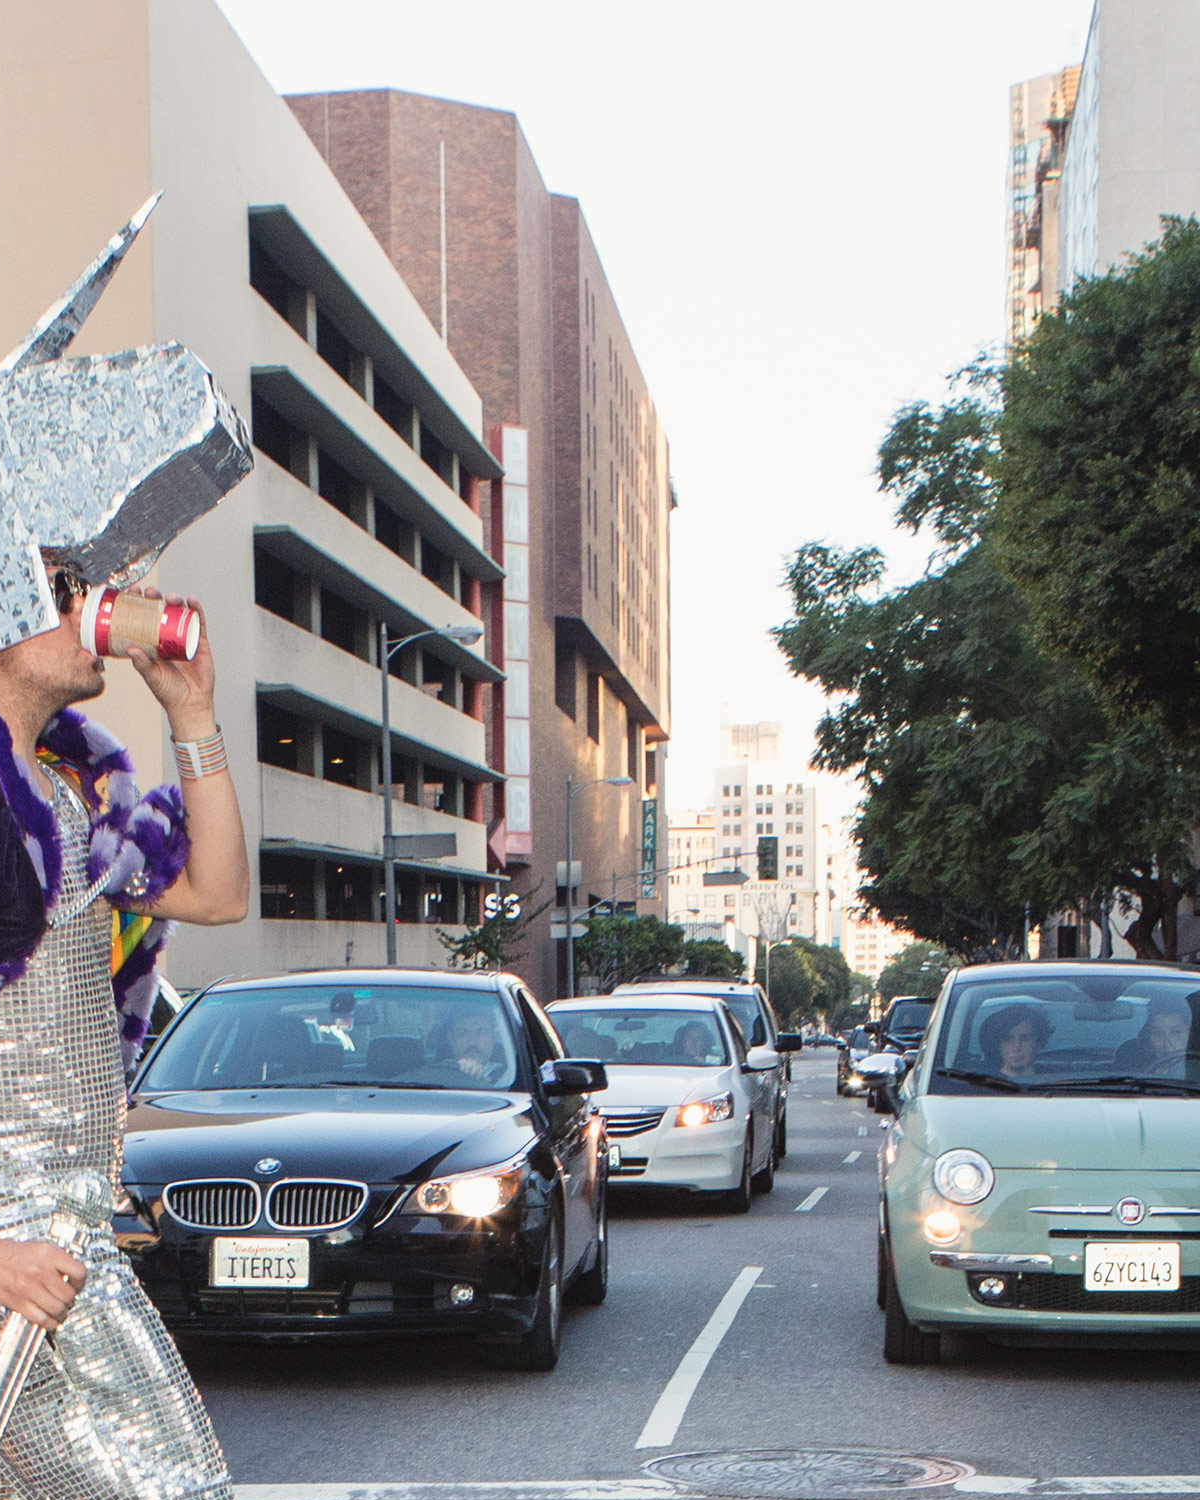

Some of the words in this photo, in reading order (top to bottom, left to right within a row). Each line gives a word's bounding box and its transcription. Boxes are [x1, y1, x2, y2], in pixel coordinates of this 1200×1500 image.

[644, 801, 655, 884] PARKING
[227, 1257, 297, 1279] ITERIS
[1093, 1262, 1172, 1282] 6ZYC143
